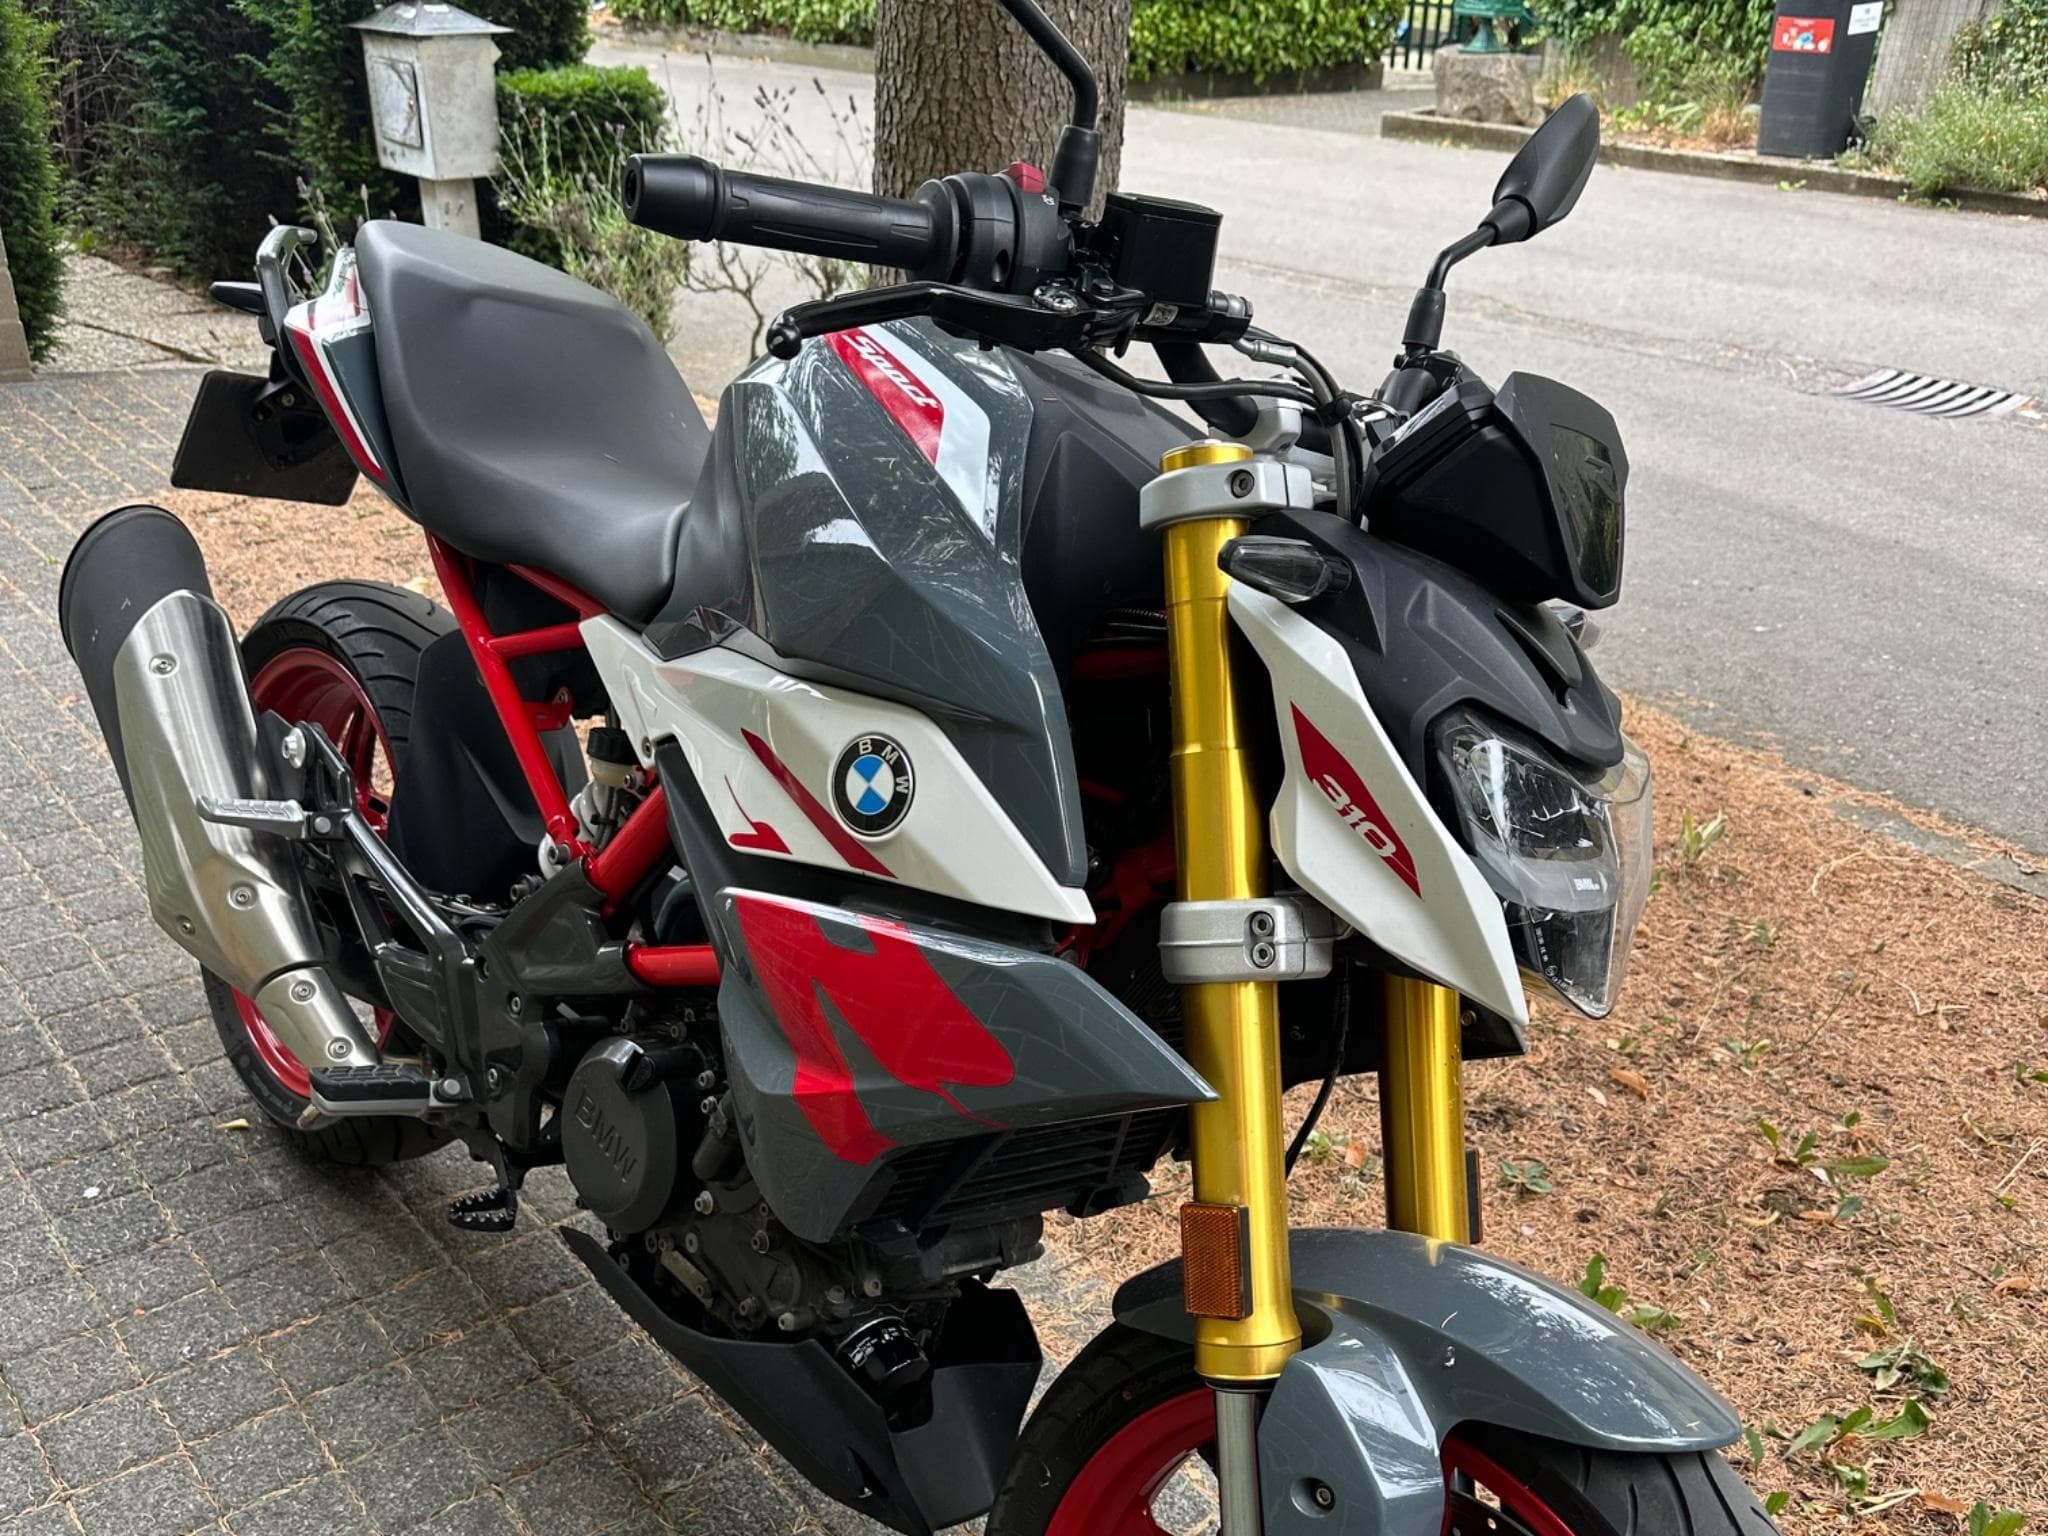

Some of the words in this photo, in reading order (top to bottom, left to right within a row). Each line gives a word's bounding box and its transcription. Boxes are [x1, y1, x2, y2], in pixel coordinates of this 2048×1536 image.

[841, 334, 939, 408] Sport
[858, 739, 909, 794] BMW
[1313, 774, 1397, 857] 310
[576, 1088, 637, 1183] BMW
